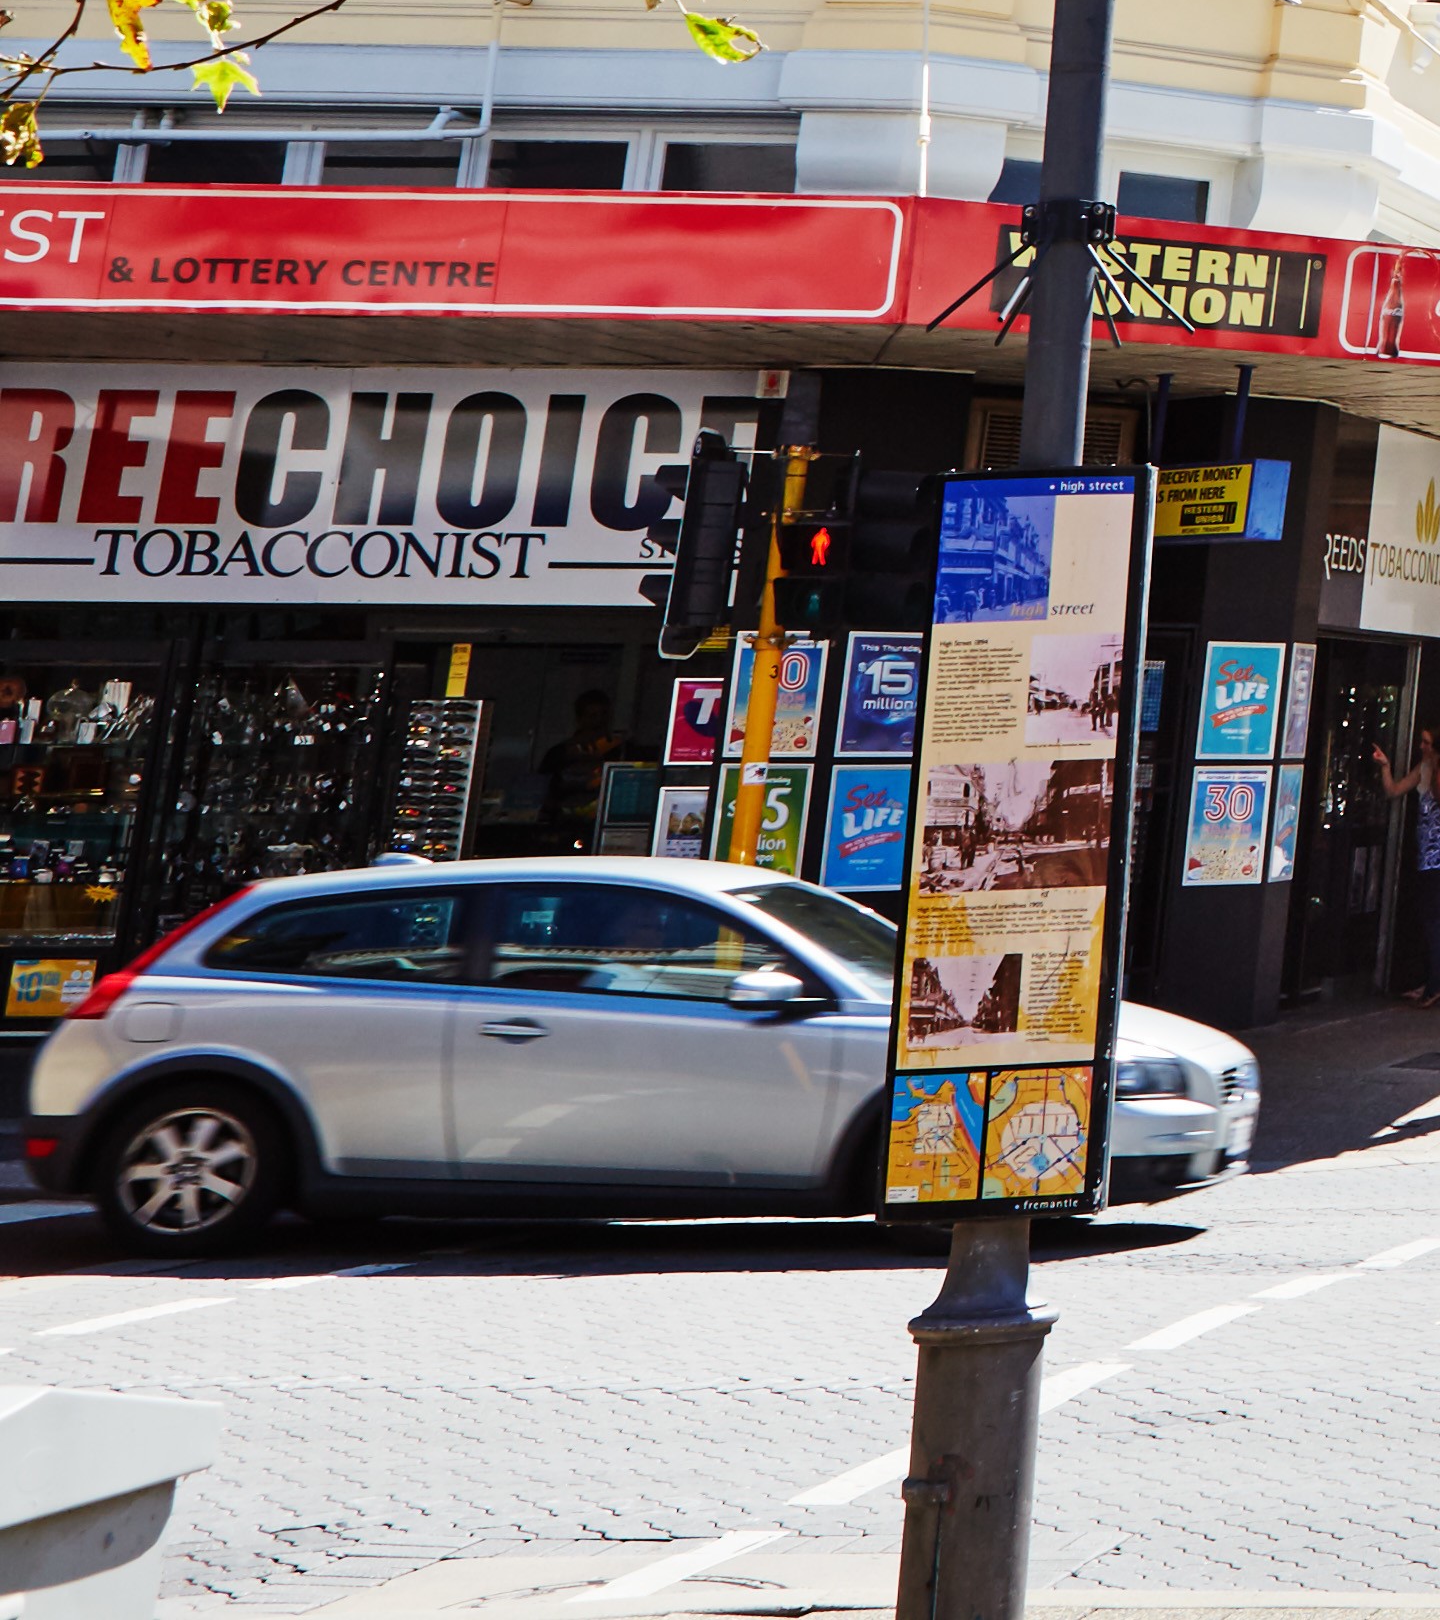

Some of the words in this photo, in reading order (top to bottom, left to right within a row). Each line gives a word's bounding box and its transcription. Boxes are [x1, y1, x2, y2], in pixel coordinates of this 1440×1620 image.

[0, 208, 105, 264] ST
[108, 256, 134, 283] &
[150, 256, 329, 287] LOTTERY
[342, 259, 496, 288] CENTRE
[1009, 233, 1269, 288] WSTERN
[1060, 480, 1085, 493] high
[1088, 480, 1124, 491] street
[1159, 470, 1200, 485] RECEIVE
[1202, 466, 1243, 481] MONEY
[1167, 488, 1197, 502] FROM
[1199, 486, 1226, 500] HERE
[93, 528, 547, 579] TOBACCONIST
[1010, 602, 1044, 621] high
[1051, 601, 1096, 615] street
[1215, 659, 1254, 686] Set
[862, 697, 914, 710] million
[1215, 681, 1269, 710] LIFE
[842, 784, 887, 812] Set
[1204, 784, 1256, 822] 30
[842, 807, 904, 838] LIFE
[1023, 1198, 1079, 1211] fremantle
